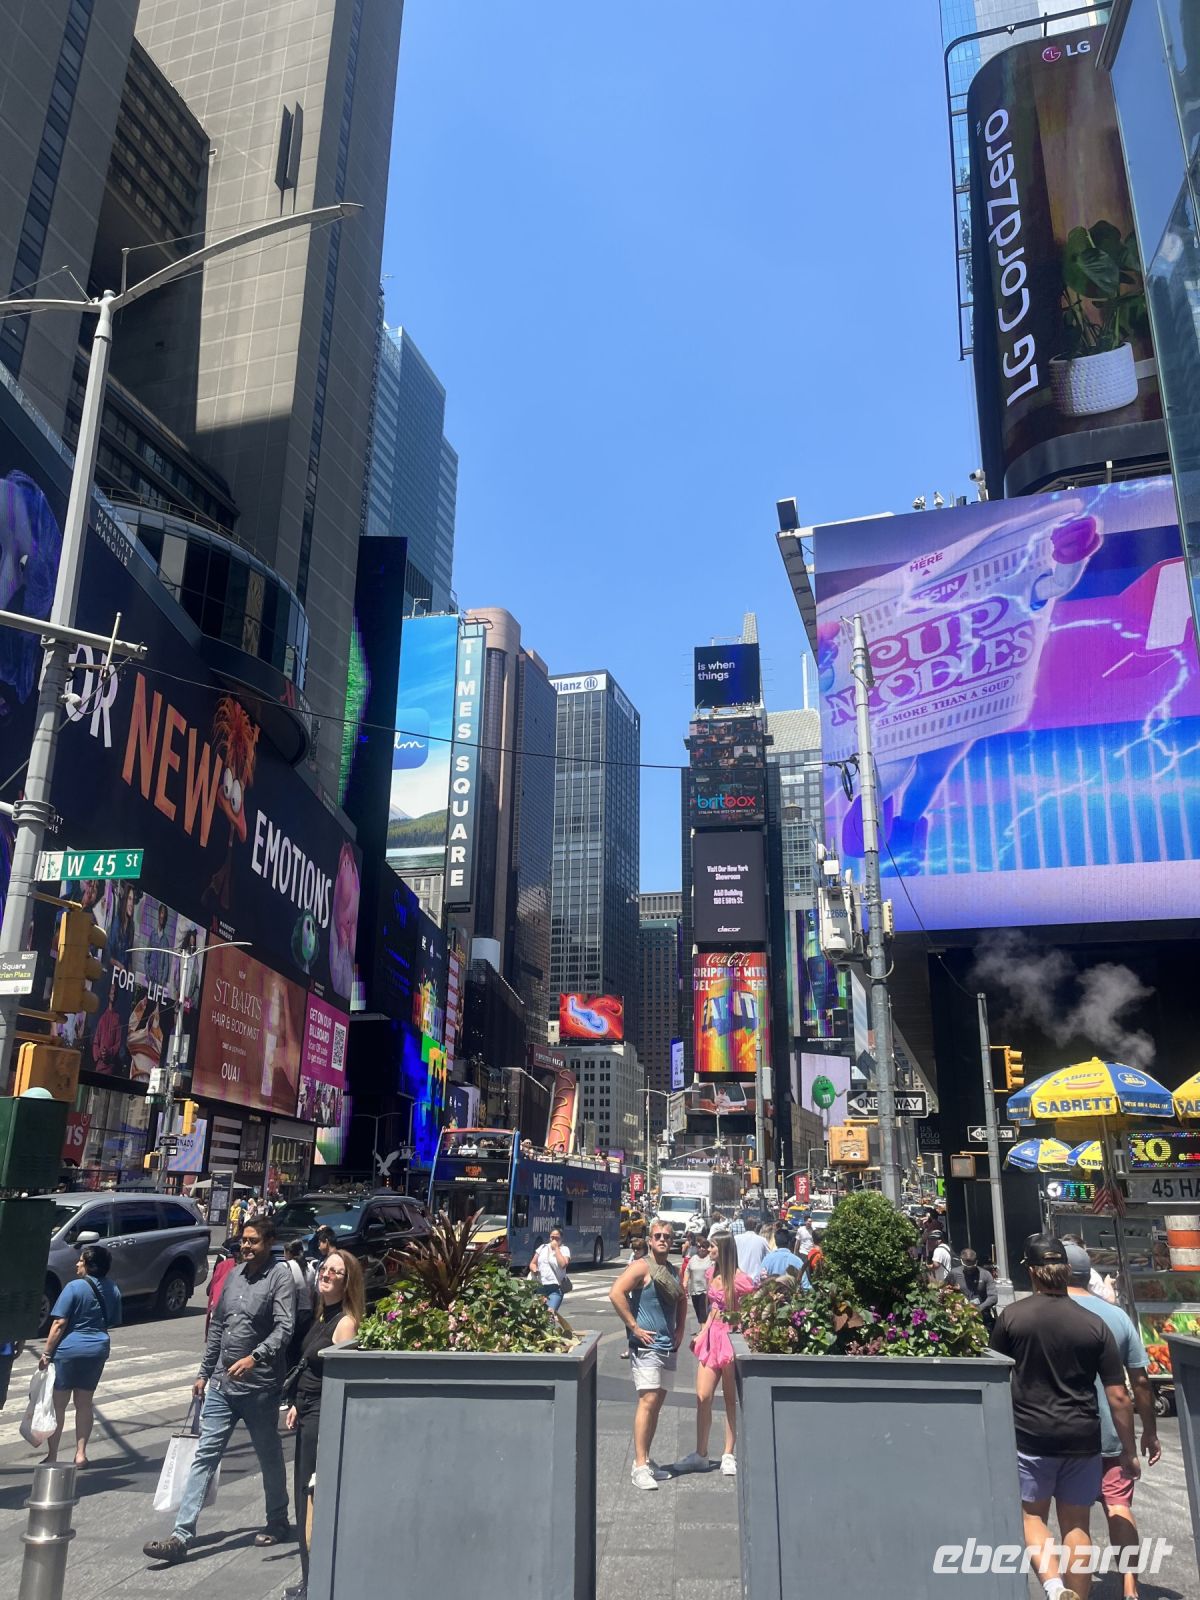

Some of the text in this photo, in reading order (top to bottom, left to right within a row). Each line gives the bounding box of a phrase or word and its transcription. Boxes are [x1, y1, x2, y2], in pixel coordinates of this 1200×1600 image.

[1066, 41, 1091, 57] LG
[984, 108, 1039, 407] LG CordZero
[95, 522, 128, 566] MARQUIS
[97, 509, 134, 558] MARRIOTT
[910, 552, 943, 573] HERE
[866, 597, 1009, 674] CUP
[697, 661, 735, 671] is when
[697, 671, 729, 681] things
[457, 639, 476, 740] TIMES
[893, 705, 928, 723] MORE
[932, 694, 968, 712] THAN
[970, 690, 979, 700] A
[982, 679, 1010, 696] SOUP
[122, 672, 223, 848] NEW
[252, 809, 333, 930] EMOTIONS
[697, 793, 756, 809] britbox
[450, 755, 472, 887] SQUARE
[66, 853, 139, 876] W 45 St
[2, 962, 26, 971] Square
[111, 965, 168, 1006] FOR LIFE
[213, 978, 262, 1020] ST BARTS
[211, 1010, 226, 1027] HAIR
[231, 1018, 247, 1036] BODY
[308, 1023, 330, 1044] BILLBOARD
[221, 1062, 240, 1082] OUAI
[857, 1098, 920, 1109] ONE WAY
[1037, 1097, 1113, 1113] SABRETT
[533, 1172, 542, 1189] WE
[633, 1173, 641, 1191] tkts
[798, 1176, 806, 1195] tkts
[1152, 1178, 1174, 1197] 45
